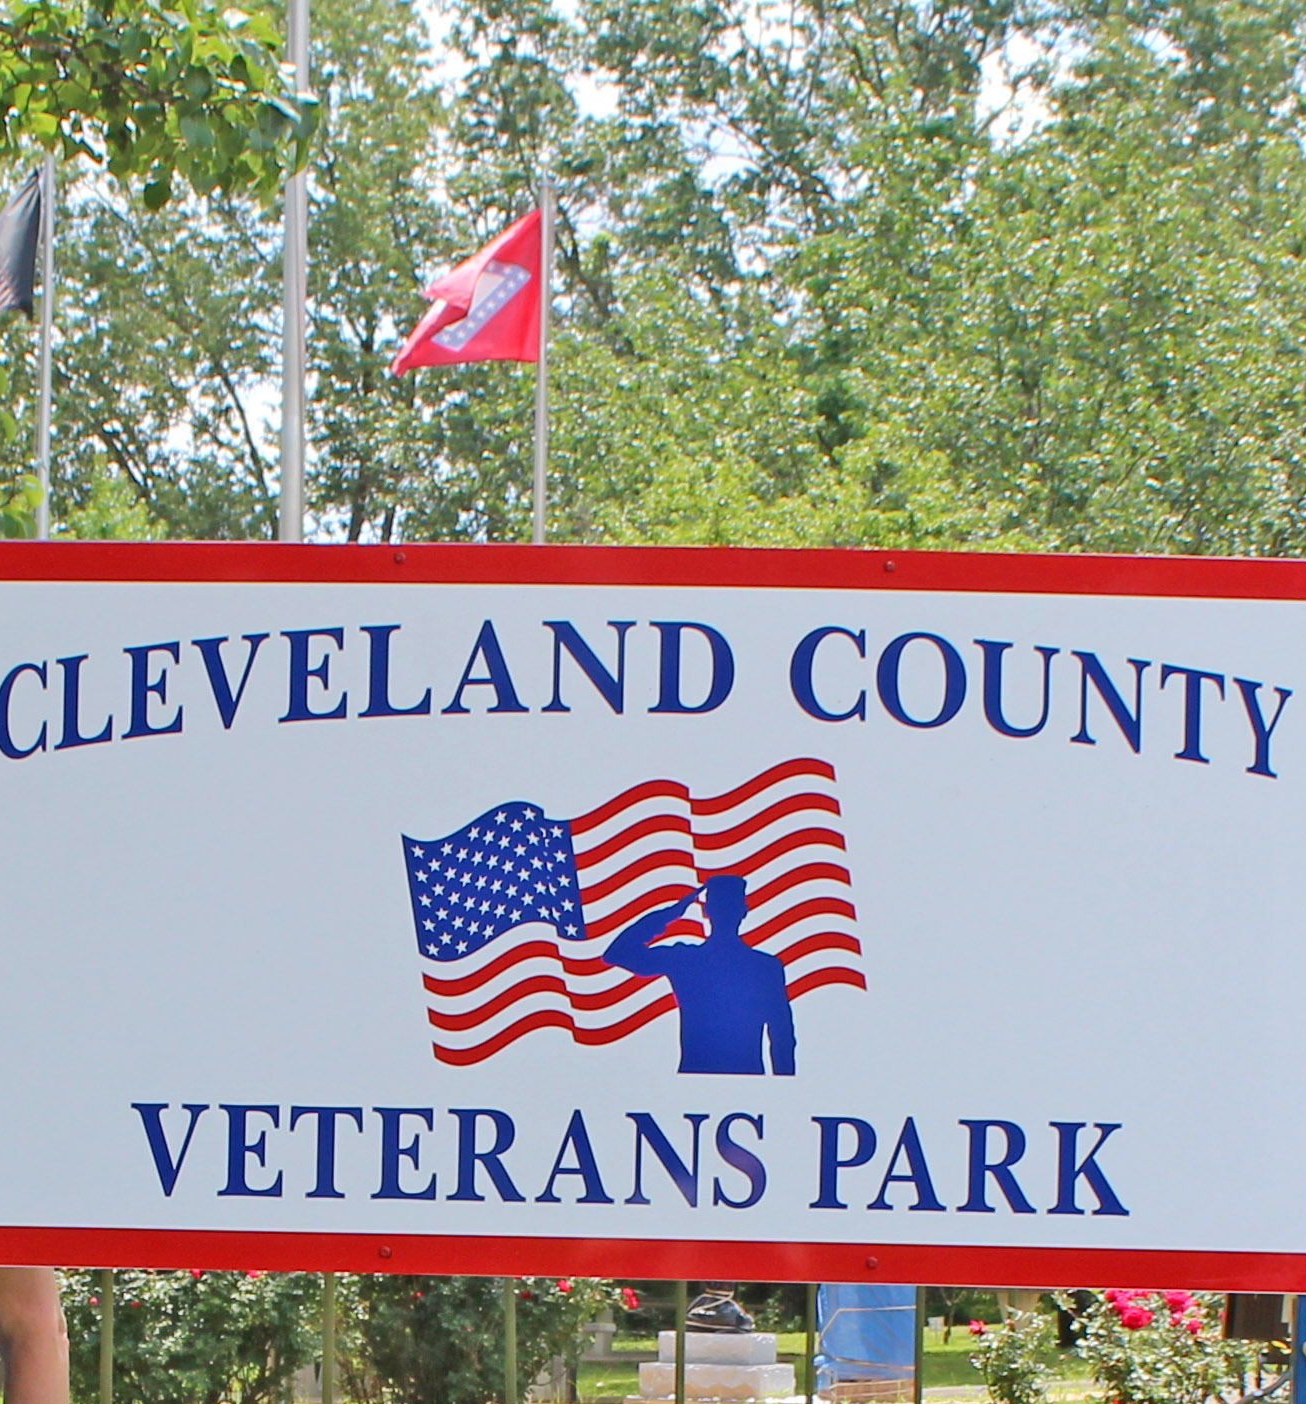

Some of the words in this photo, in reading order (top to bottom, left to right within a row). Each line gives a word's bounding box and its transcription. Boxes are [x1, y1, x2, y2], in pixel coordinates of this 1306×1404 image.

[791, 627, 1294, 780] COUNTY
[132, 1104, 768, 1211] VETERANS
[810, 1118, 1131, 1218] PARK
